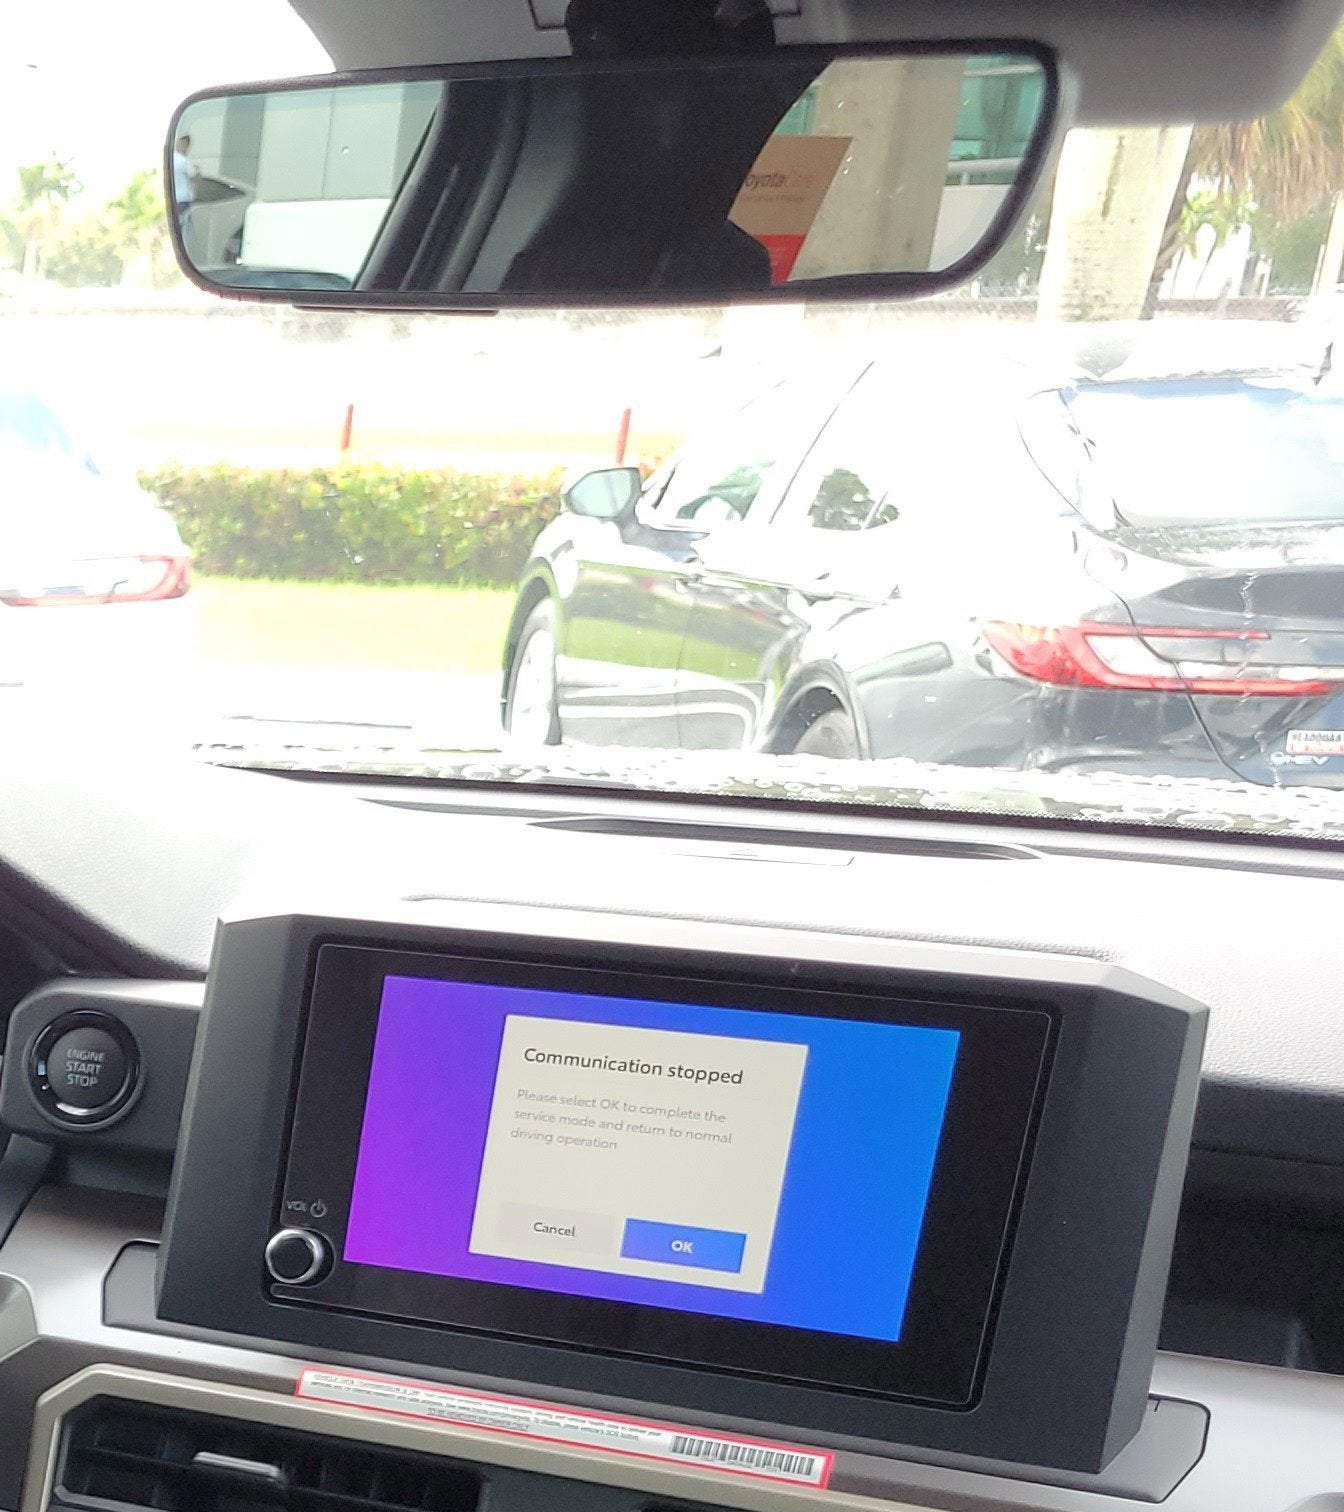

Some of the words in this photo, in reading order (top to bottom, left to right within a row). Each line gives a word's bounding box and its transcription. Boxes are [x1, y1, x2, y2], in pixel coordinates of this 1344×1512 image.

[66, 1047, 106, 1061] ENGINE
[65, 1061, 102, 1075] START
[524, 1047, 663, 1076] Communication
[667, 1064, 744, 1085] stopped
[66, 1073, 99, 1087] STOP
[517, 1088, 557, 1104] Please
[559, 1094, 597, 1109] select
[600, 1098, 620, 1111] OK
[623, 1101, 637, 1113] to
[639, 1105, 701, 1121] complete
[705, 1110, 726, 1124] the
[513, 1109, 556, 1124] service
[559, 1113, 596, 1128] mode
[598, 1118, 624, 1131] and
[626, 1122, 665, 1136] return
[669, 1126, 683, 1139] to
[685, 1130, 733, 1144] normal
[510, 1127, 553, 1144] driving
[556, 1135, 618, 1151] operation
[533, 1221, 576, 1237] Cancel
[671, 1240, 694, 1254] OK
